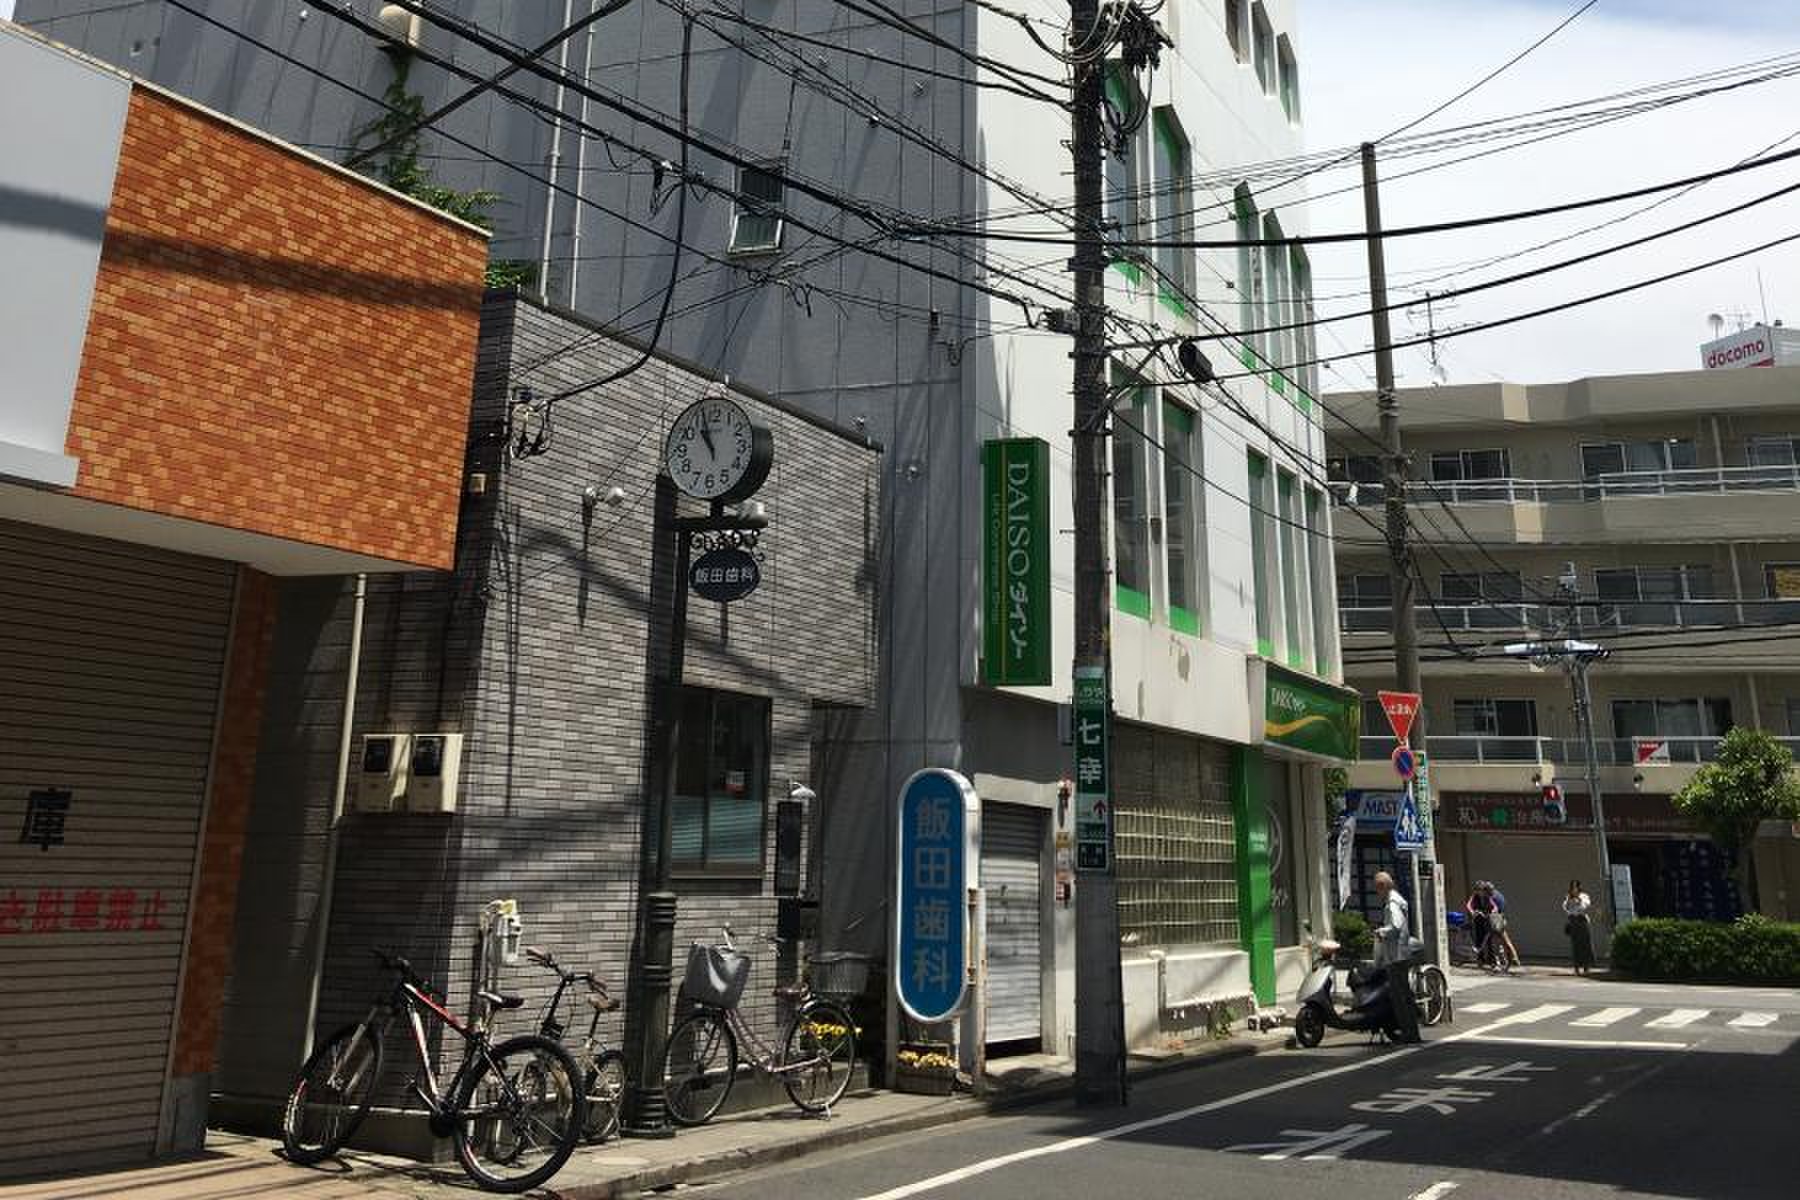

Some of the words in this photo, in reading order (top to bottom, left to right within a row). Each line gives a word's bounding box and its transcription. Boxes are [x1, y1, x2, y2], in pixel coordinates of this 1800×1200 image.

[1707, 339, 1765, 369] docomo
[1008, 463, 1030, 576] DAISO
[1009, 580, 1028, 659] ダイソー
[20, 787, 73, 852] 庫
[914, 798, 951, 992] 飯田歯科
